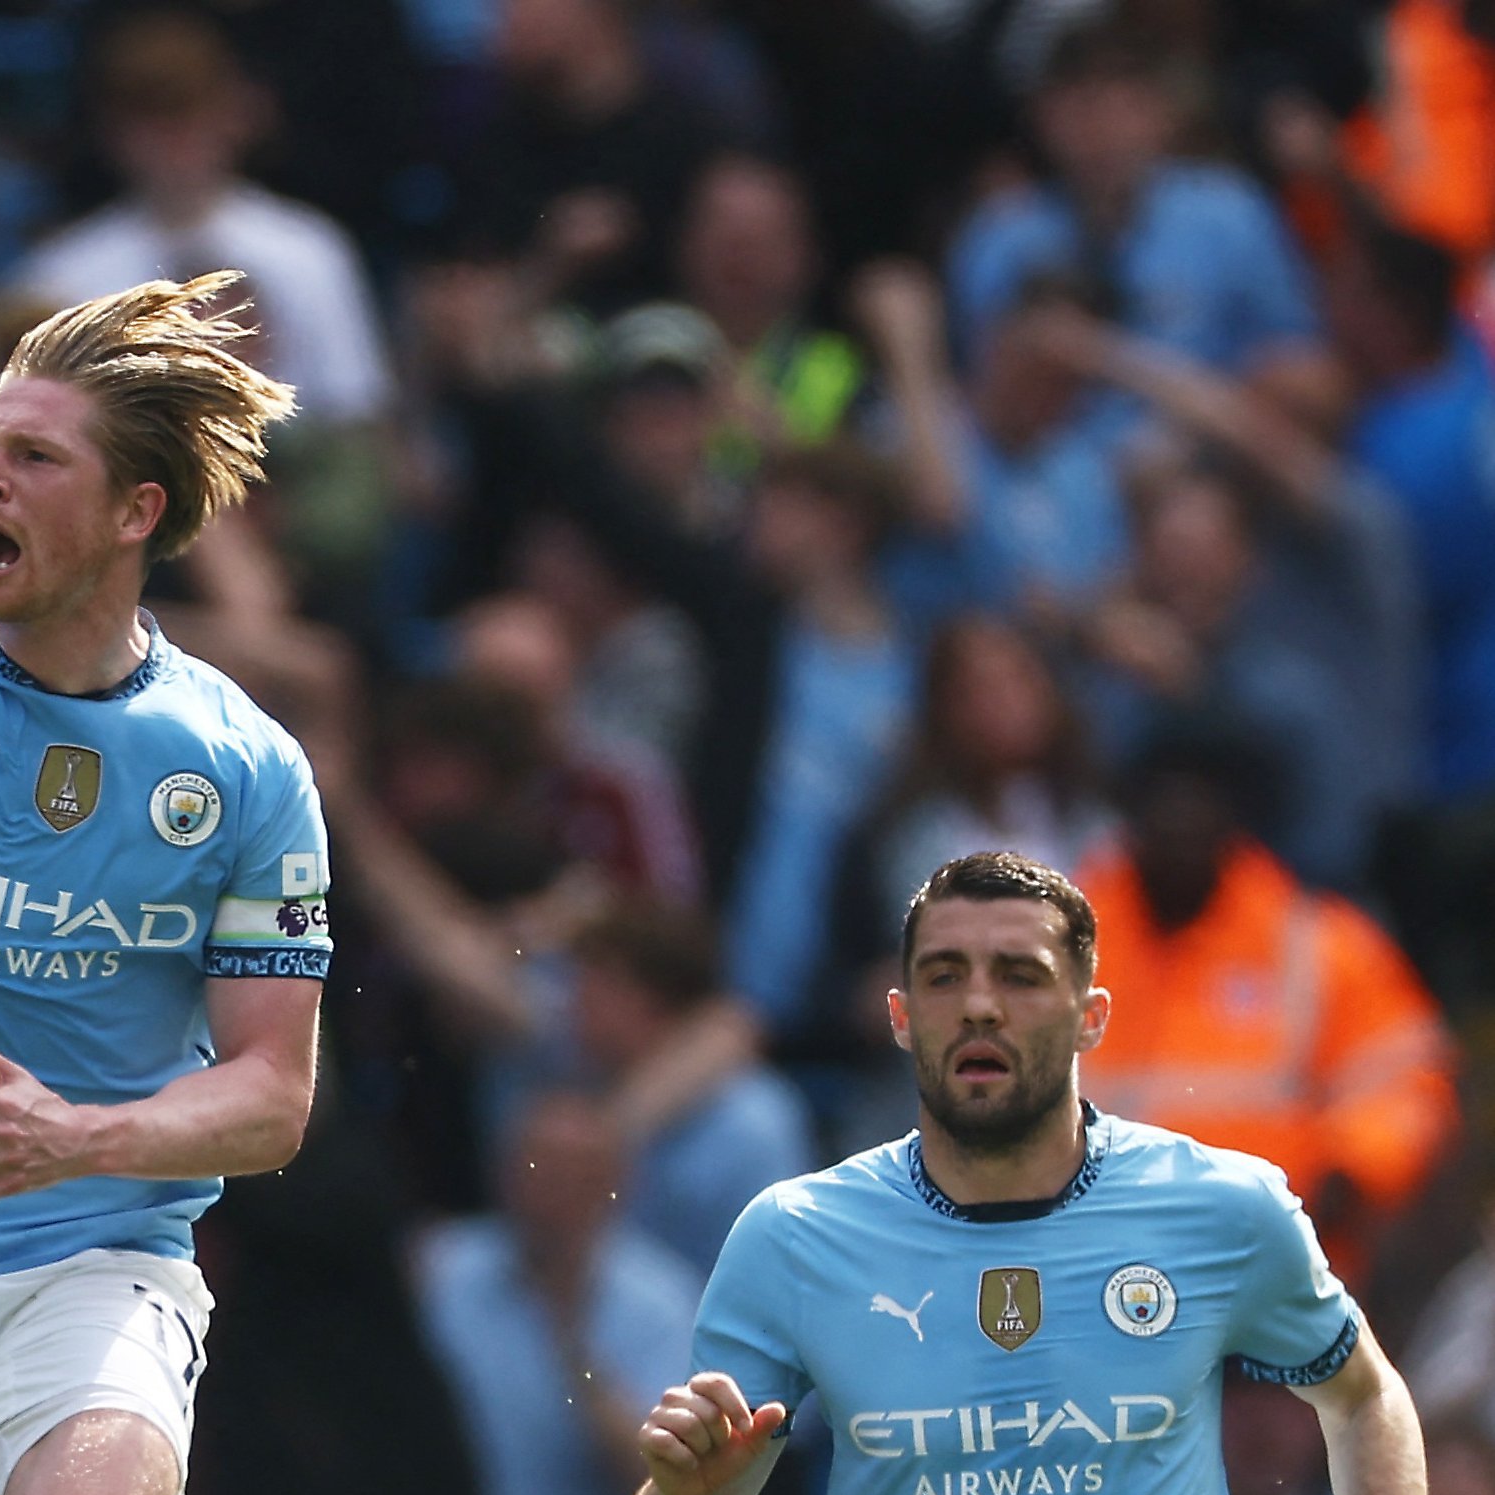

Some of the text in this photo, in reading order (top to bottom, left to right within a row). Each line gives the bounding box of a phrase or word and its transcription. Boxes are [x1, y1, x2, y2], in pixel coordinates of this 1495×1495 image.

[158, 775, 218, 805] MANCHESTER
[51, 798, 78, 813] FIFA
[168, 833, 190, 844] CITY
[1110, 1268, 1169, 1291] MANCHESTER
[997, 1319, 1024, 1331] FIFA
[1132, 1326, 1154, 1335] CITY
[849, 1394, 1176, 1458] ETIHAD
